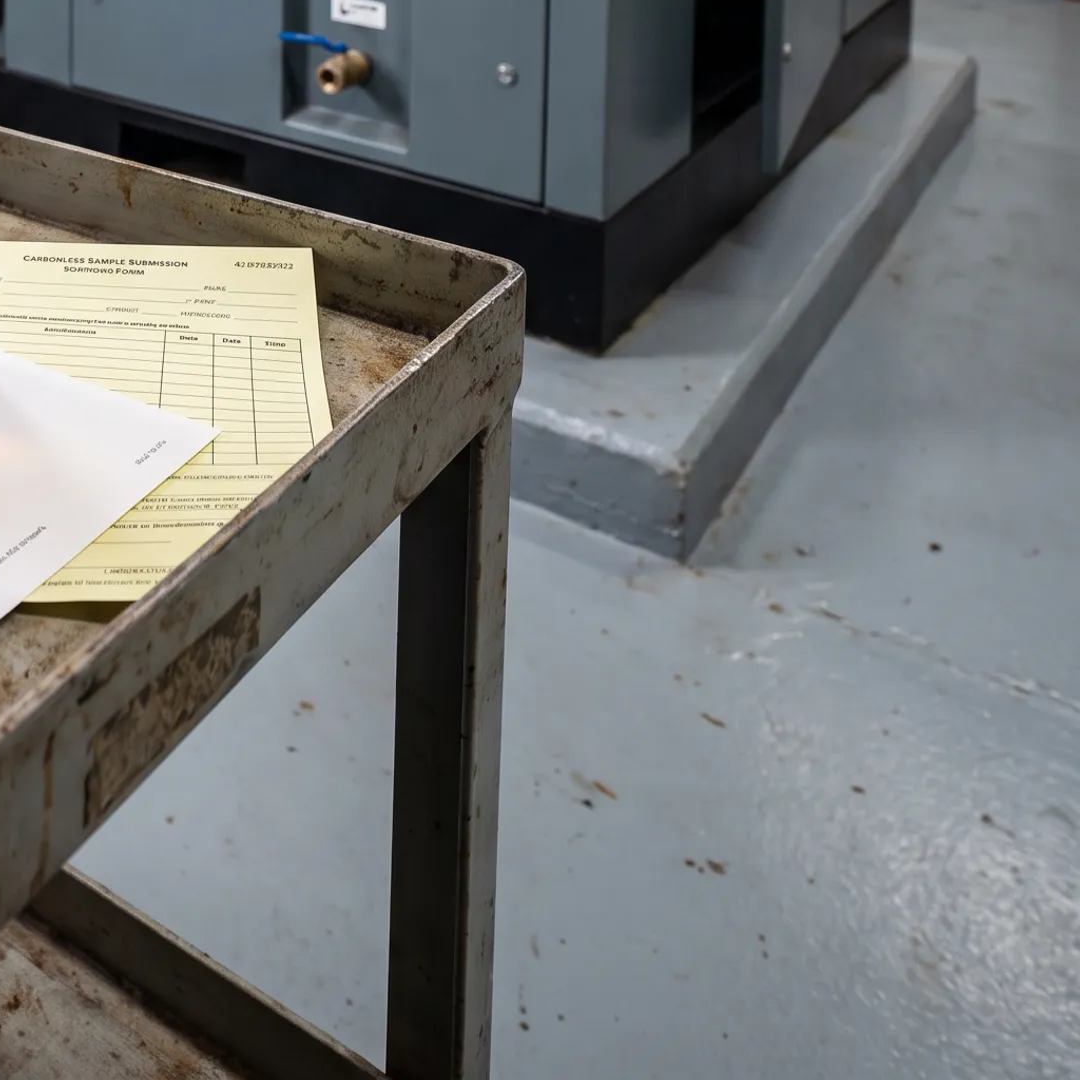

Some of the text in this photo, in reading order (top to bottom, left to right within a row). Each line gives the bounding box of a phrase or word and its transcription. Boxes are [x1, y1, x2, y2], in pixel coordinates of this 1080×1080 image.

[23, 255, 188, 268] CARBONLESS SAMPLE SUBMISSION
